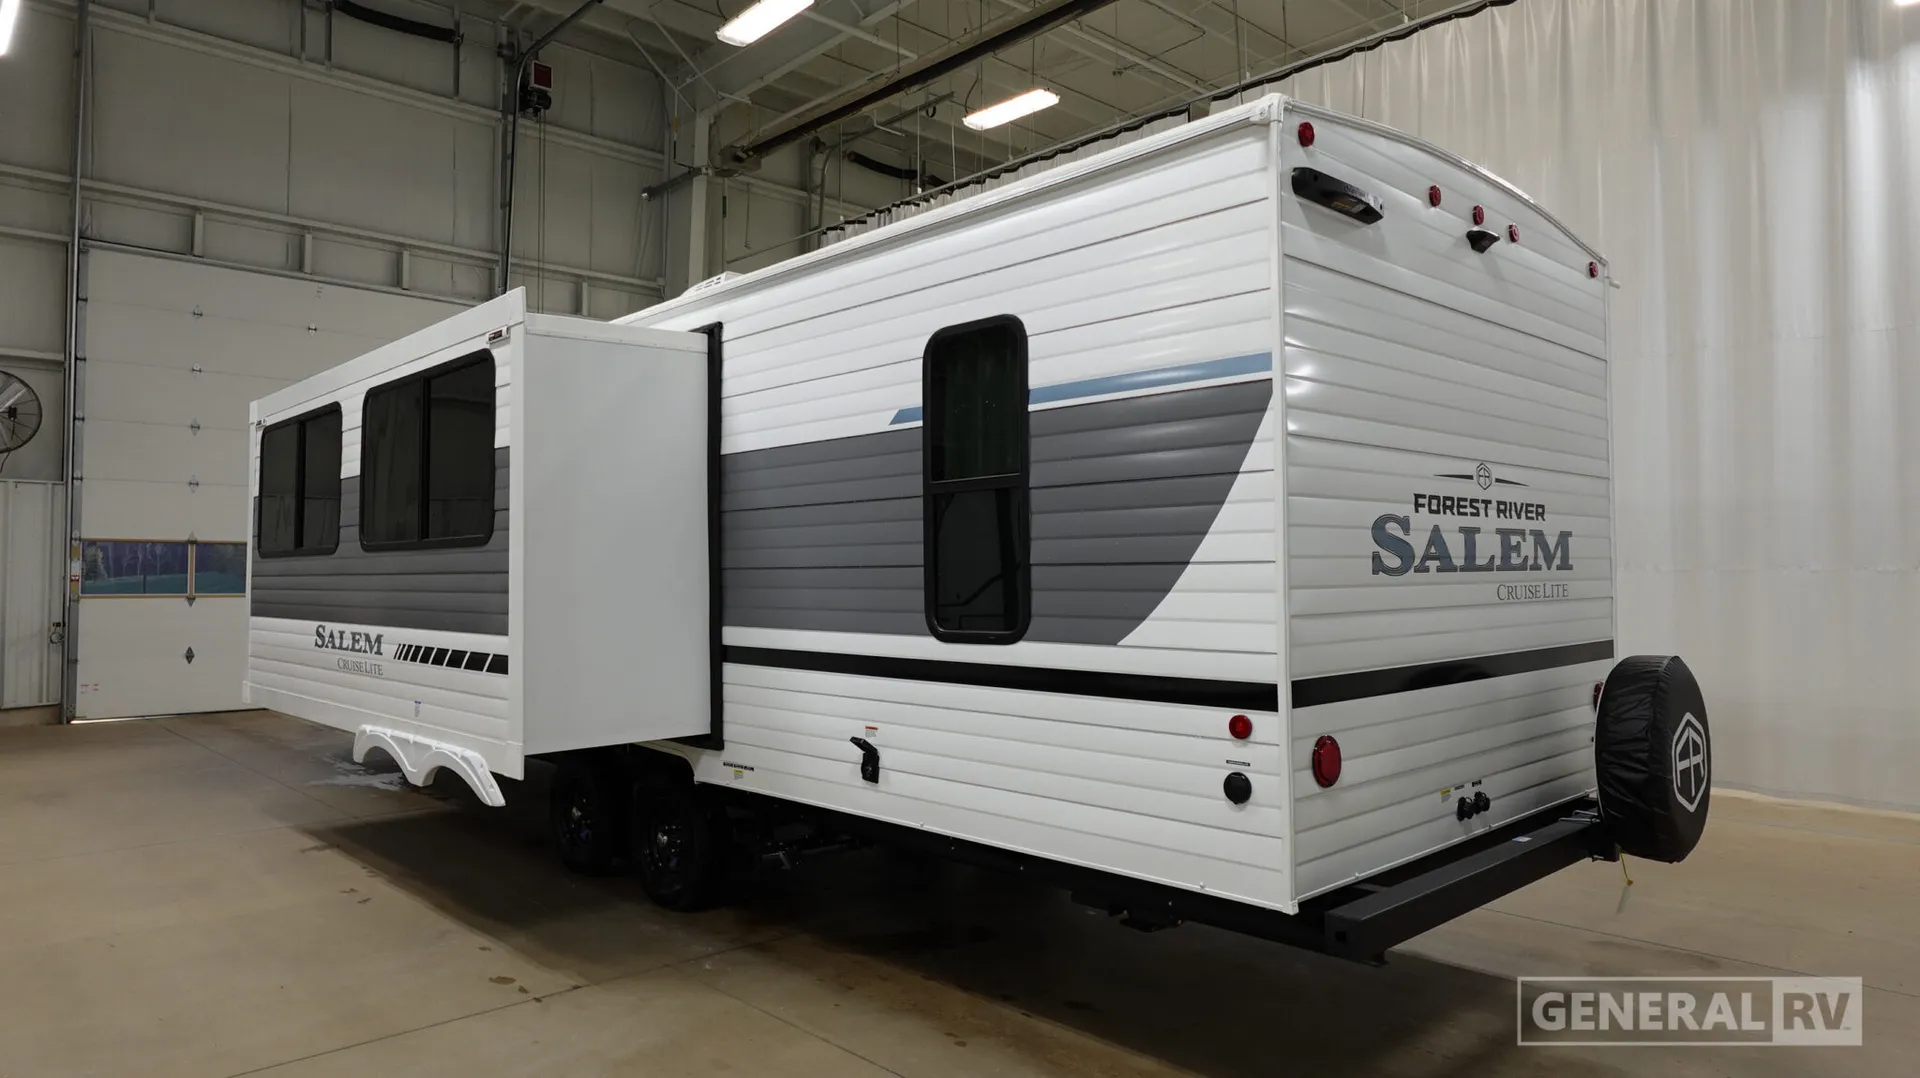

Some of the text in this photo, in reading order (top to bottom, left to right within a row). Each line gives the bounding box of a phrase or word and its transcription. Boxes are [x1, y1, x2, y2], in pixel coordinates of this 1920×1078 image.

[1413, 493, 1546, 521] FOREST RIVER
[1371, 513, 1573, 577] SALEM
[315, 624, 383, 655] SALEM
